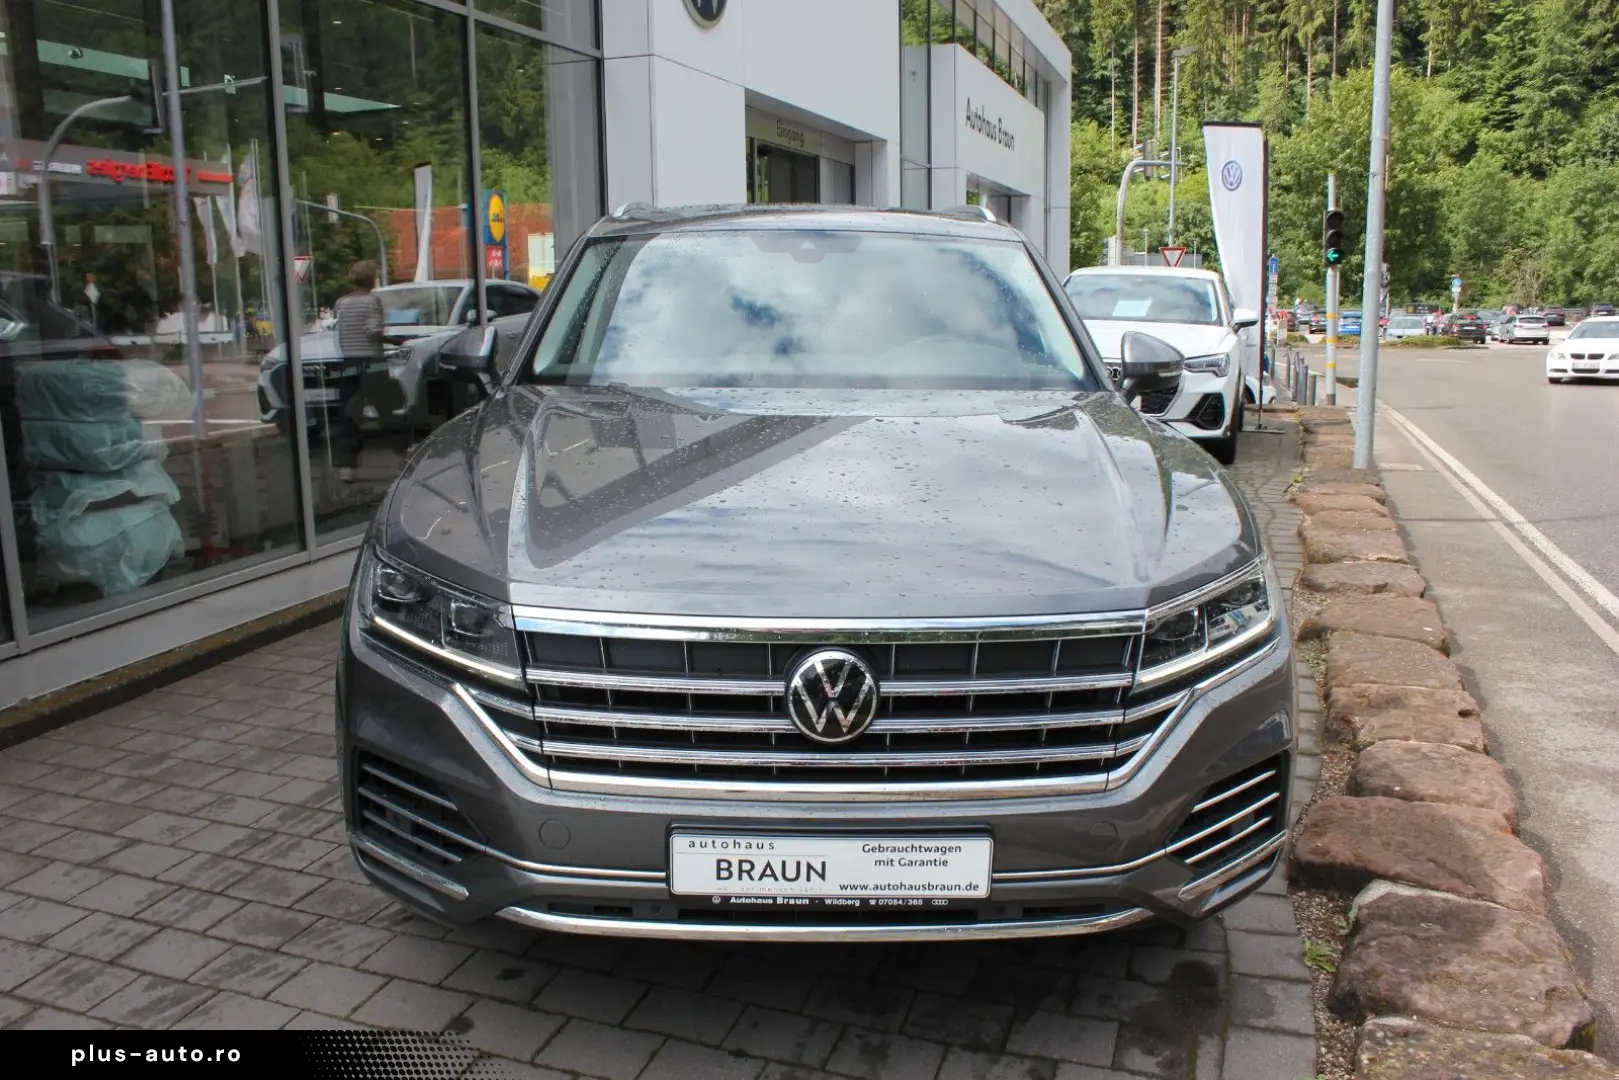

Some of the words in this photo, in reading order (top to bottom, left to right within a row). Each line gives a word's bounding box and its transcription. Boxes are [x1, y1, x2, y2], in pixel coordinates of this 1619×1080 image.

[965, 97, 997, 142] Autohaus
[998, 116, 1015, 152] Braun
[776, 118, 804, 149] Eingang
[688, 839, 775, 850] autohaus
[862, 843, 962, 855] Gebrauchtwagen
[874, 857, 895, 867] mit
[898, 857, 949, 867] Garantie
[715, 858, 827, 882] BRAUN
[839, 881, 980, 892] www.autohausbraun.de
[730, 896, 774, 905] Autohaus
[776, 897, 810, 905] Braun
[824, 898, 861, 907] Wildberg
